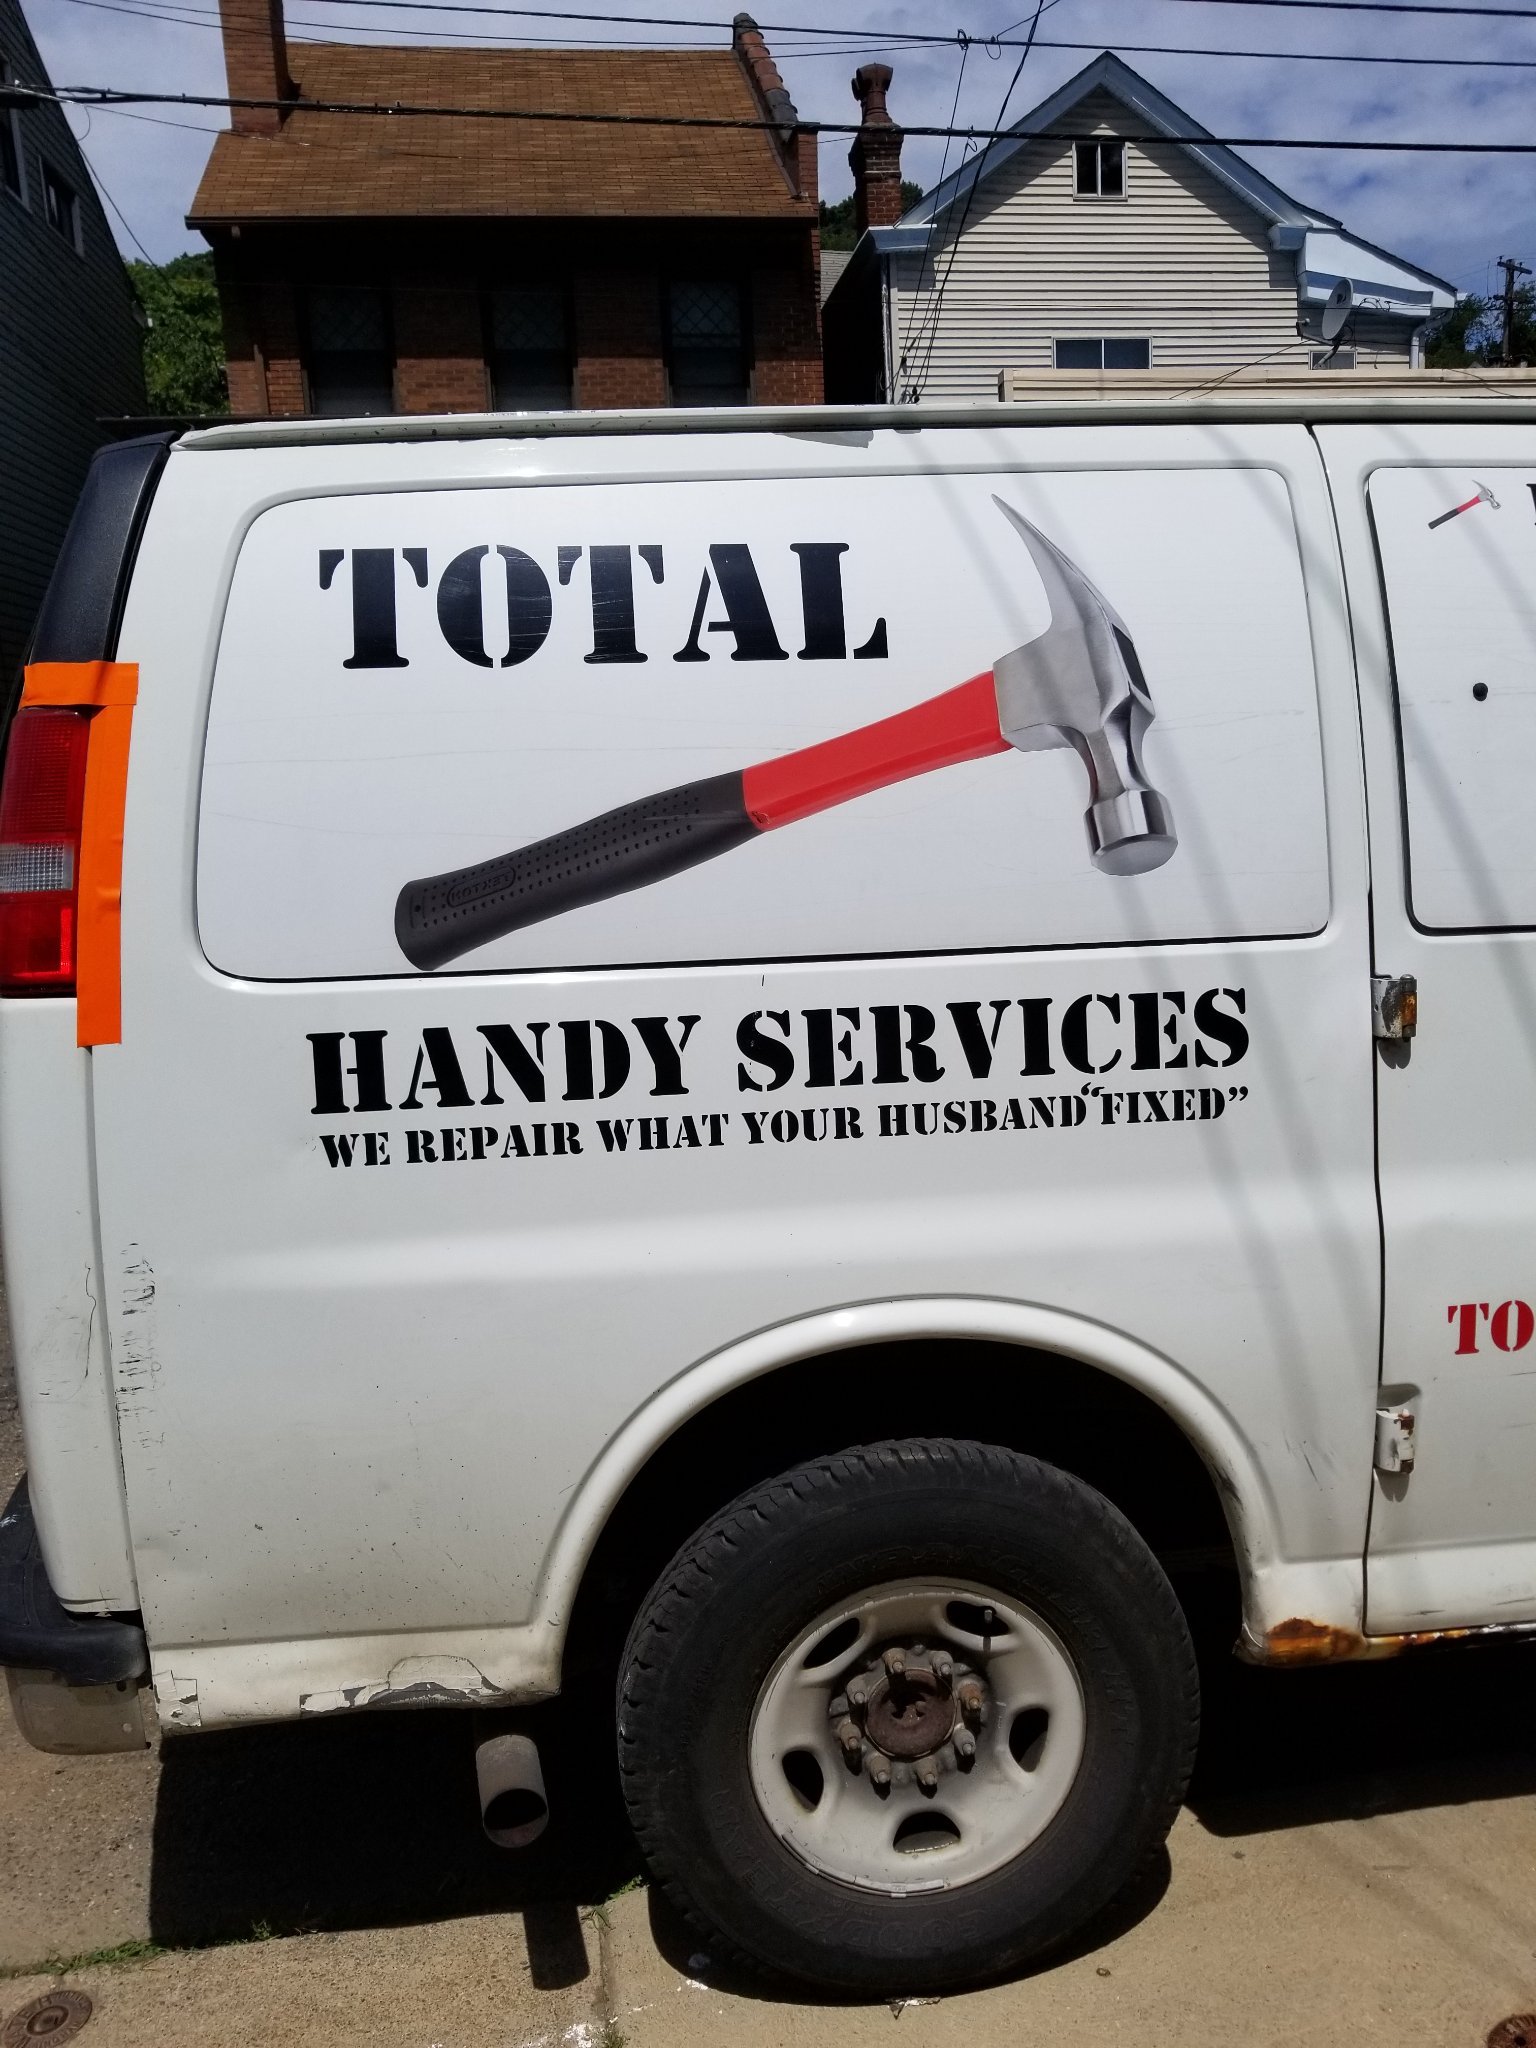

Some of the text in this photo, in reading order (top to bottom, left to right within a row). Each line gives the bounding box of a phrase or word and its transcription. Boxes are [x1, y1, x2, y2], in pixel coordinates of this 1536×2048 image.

[318, 543, 889, 670] TOTAL
[305, 987, 1250, 1115] HANDY SERVICES
[319, 1131, 391, 1169] WE
[404, 1121, 584, 1164] REPAIR
[595, 1113, 729, 1153] WHAT
[741, 1106, 864, 1145] YOUR
[877, 1095, 1087, 1137] HUSBAND
[1447, 1299, 1535, 1355] TO
[708, 1788, 990, 1951] GOODYEAR
